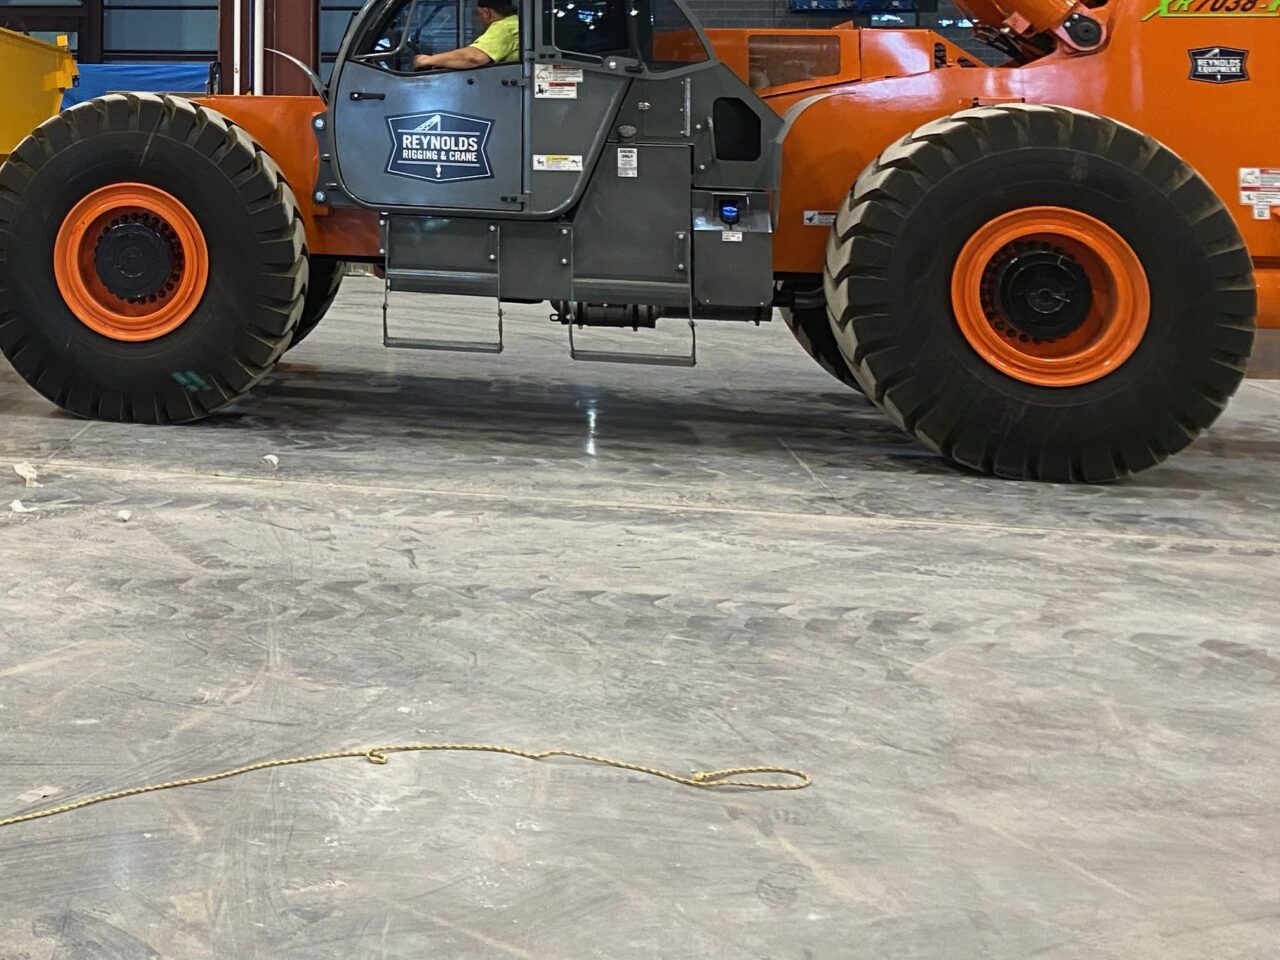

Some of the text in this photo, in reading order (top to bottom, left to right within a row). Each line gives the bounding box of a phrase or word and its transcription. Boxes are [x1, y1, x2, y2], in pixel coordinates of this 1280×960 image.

[402, 134, 478, 151] REYNOLDS
[402, 149, 477, 162] RIGGING & CRANE
